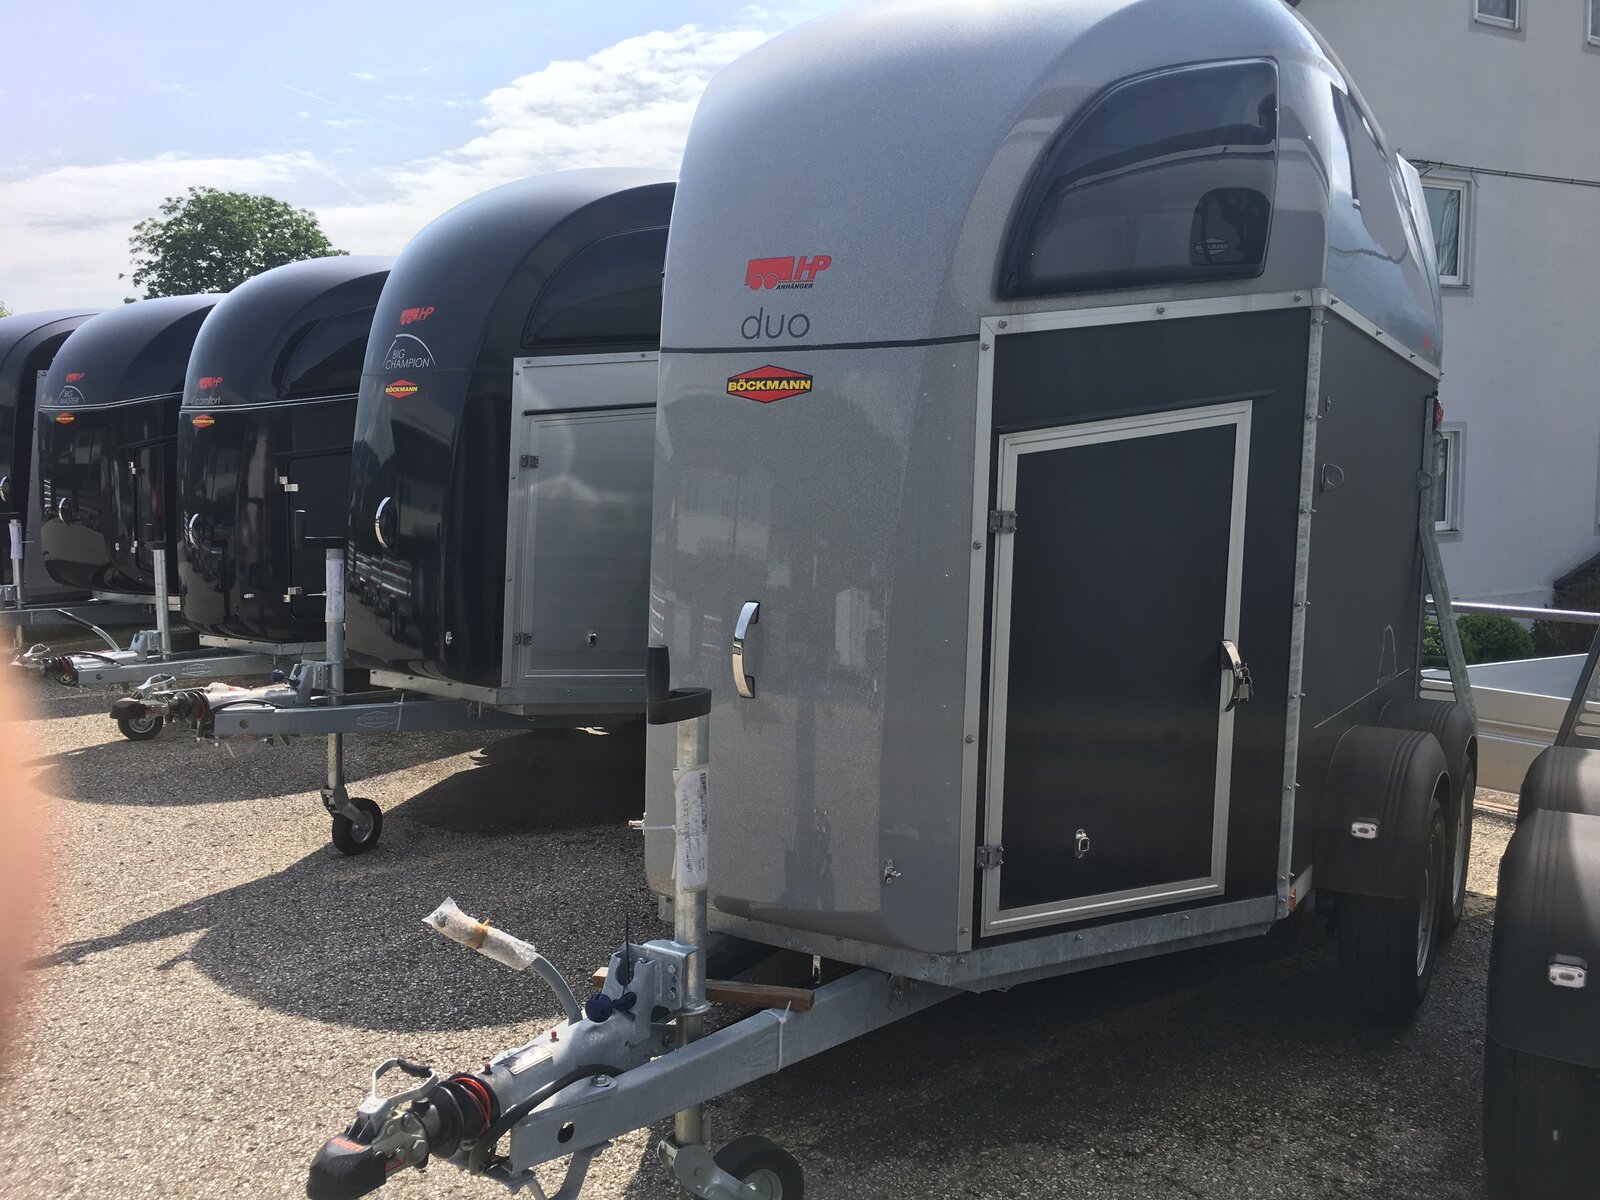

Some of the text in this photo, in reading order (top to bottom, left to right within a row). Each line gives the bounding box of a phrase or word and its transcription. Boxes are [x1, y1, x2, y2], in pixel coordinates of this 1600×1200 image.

[794, 254, 832, 281] HP
[419, 307, 434, 320] HP
[741, 306, 810, 340] duo
[392, 348, 406, 359] BIG
[386, 358, 430, 369] CHAMPION
[728, 379, 811, 392] BÖCKMANN
[195, 396, 221, 406] comfort
